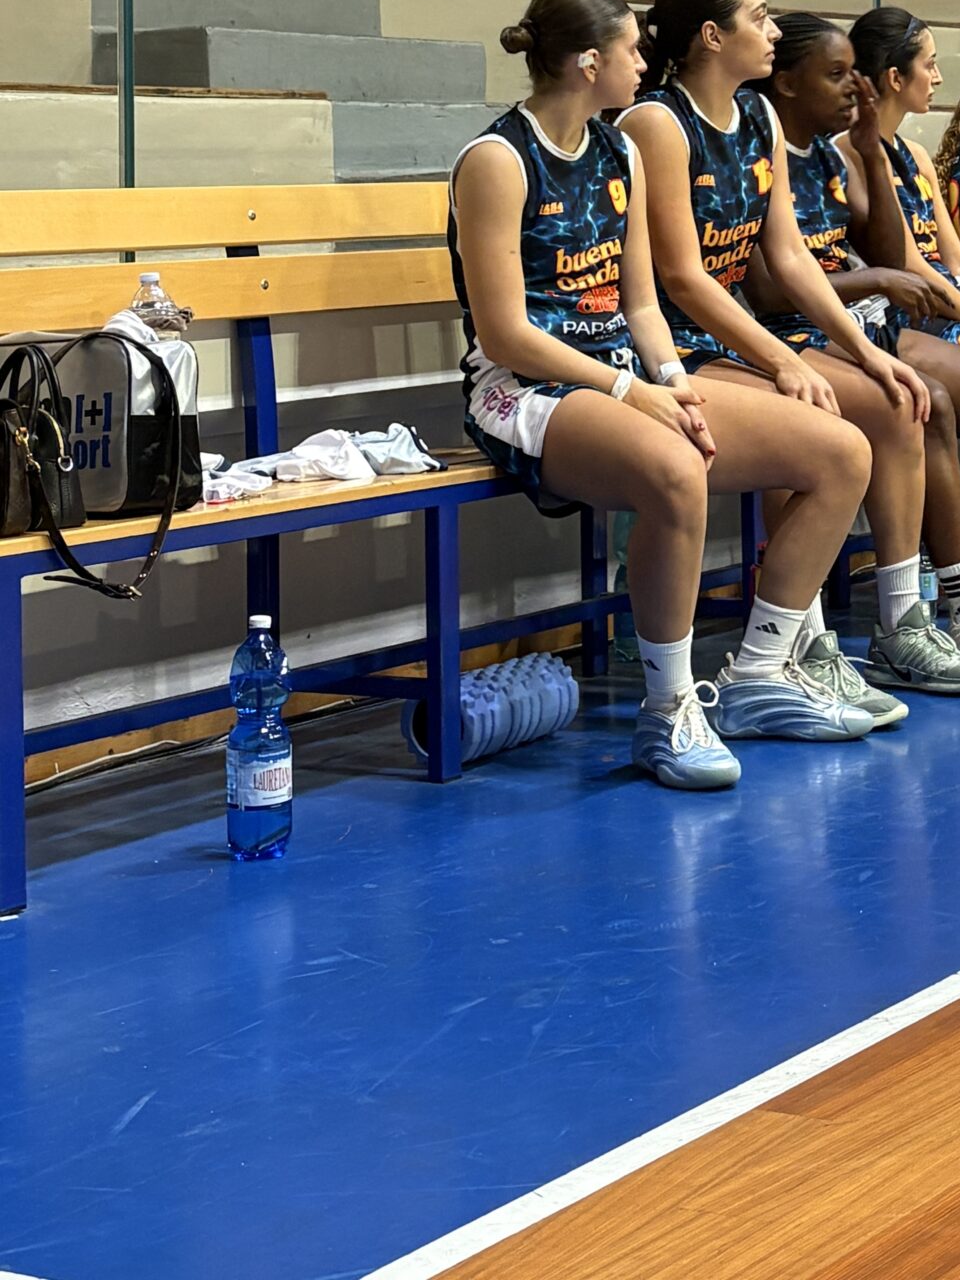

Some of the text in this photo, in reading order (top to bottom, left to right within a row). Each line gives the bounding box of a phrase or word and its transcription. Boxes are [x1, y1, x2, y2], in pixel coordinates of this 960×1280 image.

[607, 177, 628, 216] 9
[556, 261, 620, 293] onda
[73, 434, 112, 470] ort
[252, 767, 291, 792] LAURETAN
